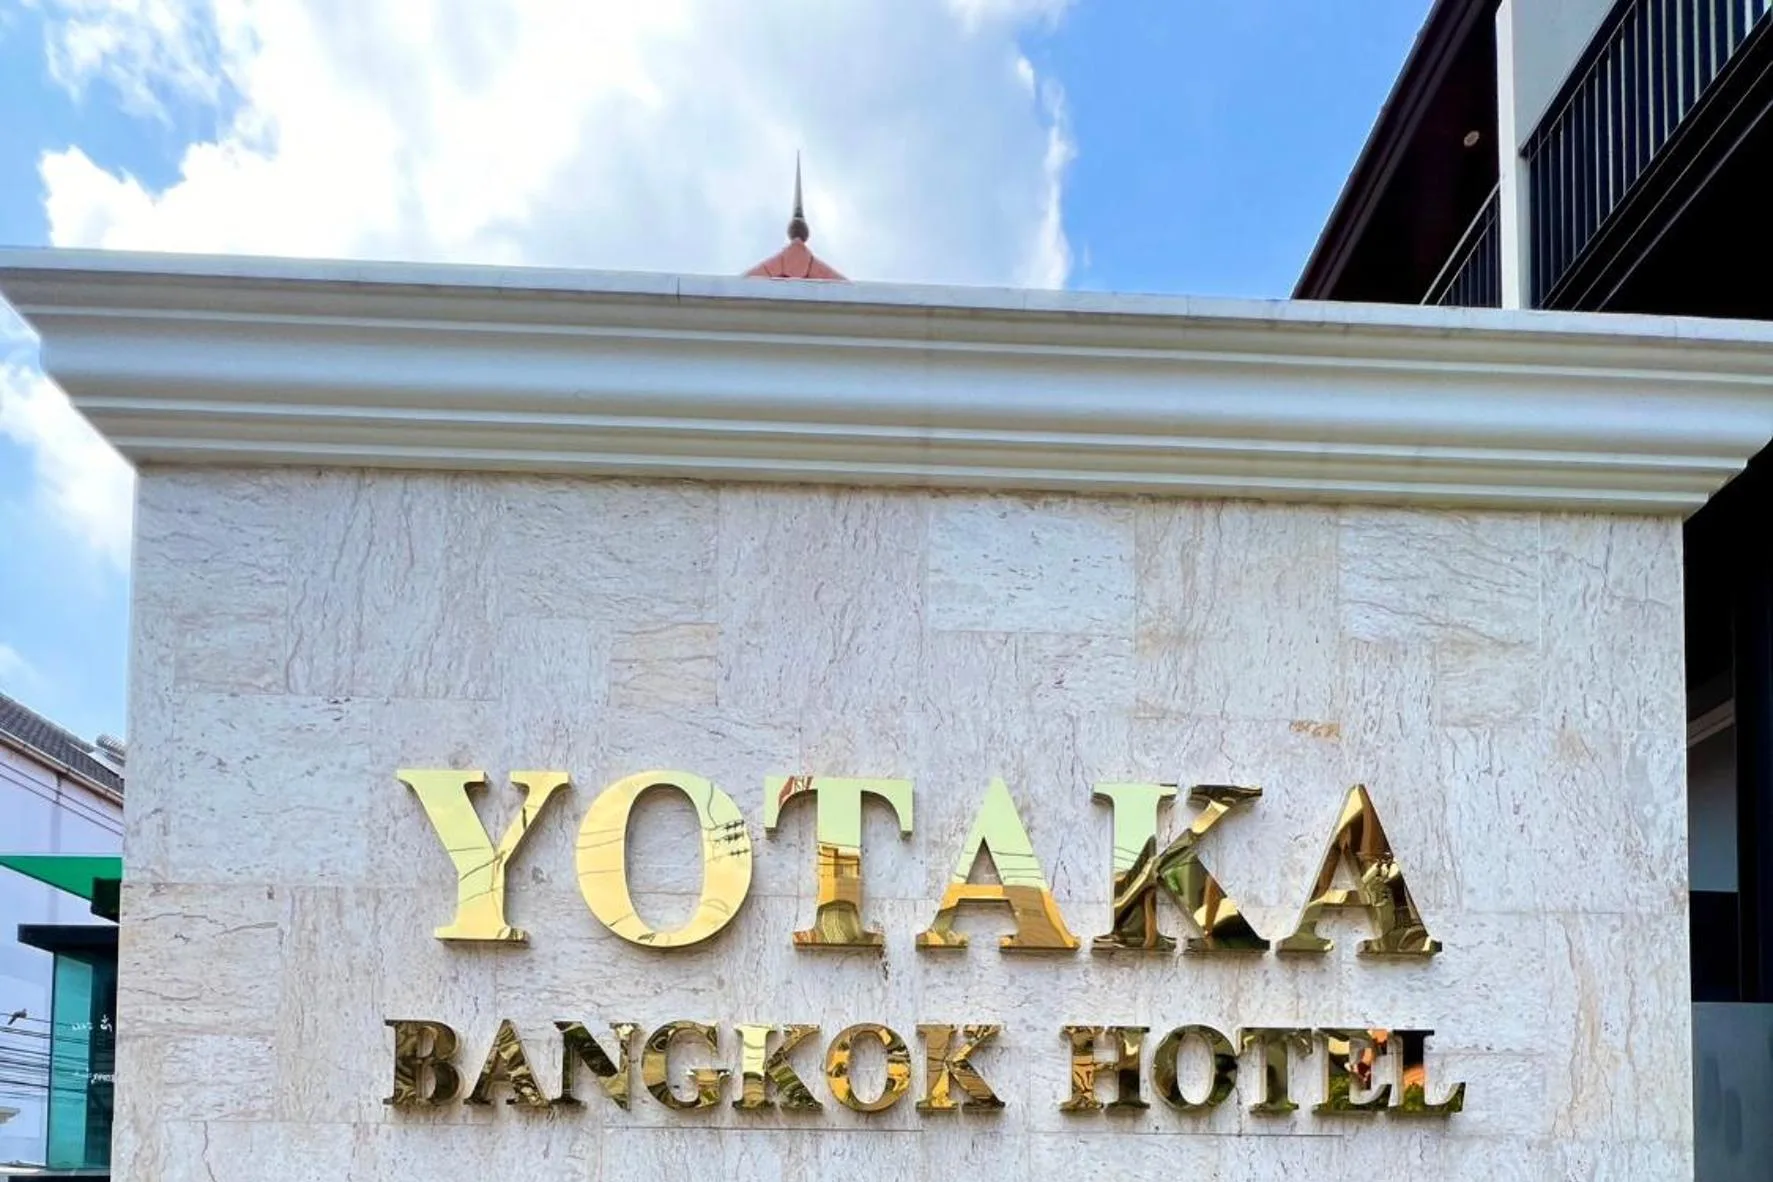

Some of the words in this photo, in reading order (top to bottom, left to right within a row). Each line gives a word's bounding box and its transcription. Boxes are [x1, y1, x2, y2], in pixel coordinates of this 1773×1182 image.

[396, 768, 1443, 954] YOTAKA
[383, 1019, 1006, 1113] BANGKOK
[1059, 1024, 1467, 1117] HOTEL
